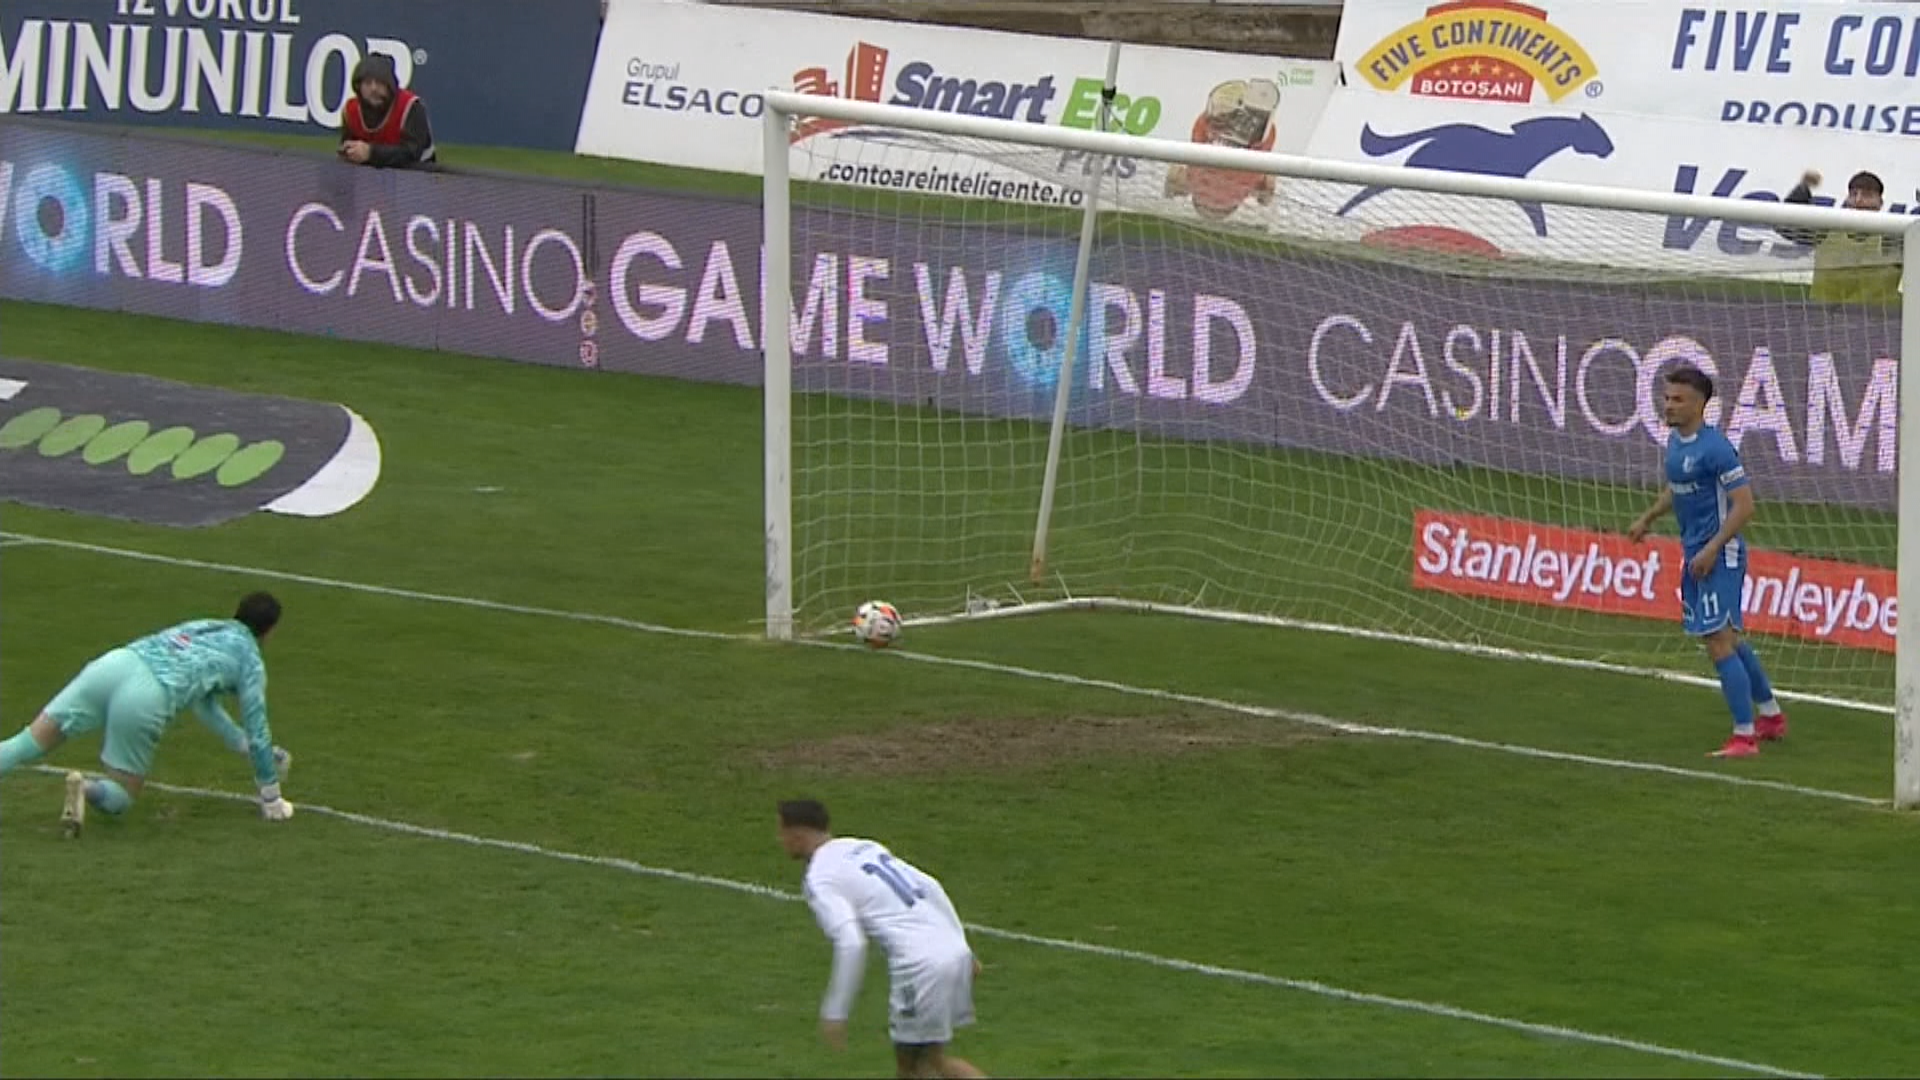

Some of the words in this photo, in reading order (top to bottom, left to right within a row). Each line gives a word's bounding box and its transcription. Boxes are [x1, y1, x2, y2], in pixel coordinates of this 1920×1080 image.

[627, 57, 680, 83] Grupul
[1370, 34, 1426, 83] FIVE
[1431, 19, 1582, 86] CONTINENTS
[1671, 9, 1800, 73] FIVE
[622, 81, 765, 118] ELSACO
[888, 61, 1057, 124] Smart
[286, 202, 586, 321] CASINO
[610, 231, 889, 364] GAME
[913, 262, 1257, 404] WORLD
[1308, 315, 1641, 436] CASINO
[1418, 521, 1661, 601] Stanleybet
[1702, 592, 1719, 617] 11
